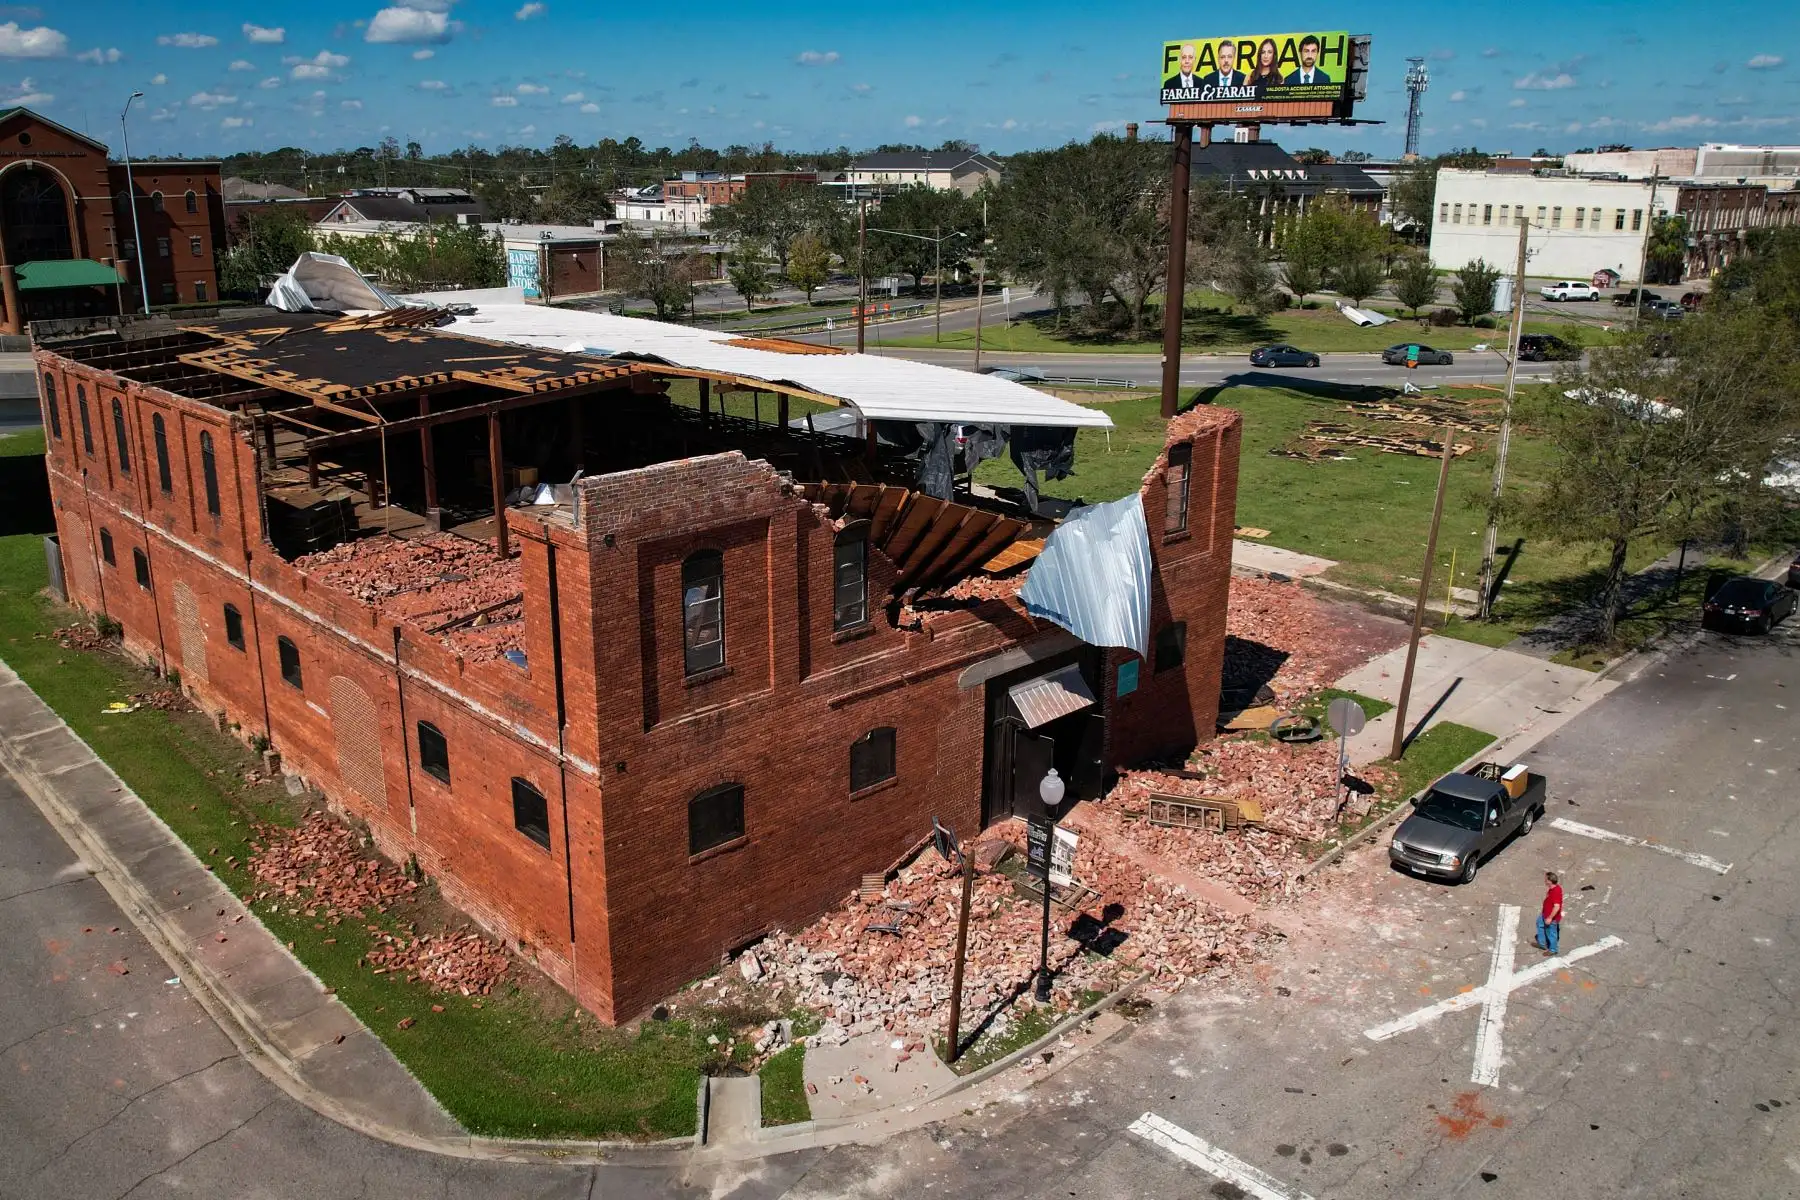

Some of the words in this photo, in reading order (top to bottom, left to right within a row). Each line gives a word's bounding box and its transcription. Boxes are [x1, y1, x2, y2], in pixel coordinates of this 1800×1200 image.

[1162, 87, 1200, 100] FARAH
[1201, 84, 1216, 101] &
[1216, 86, 1255, 98] FARAH
[511, 264, 537, 278] DRUG
